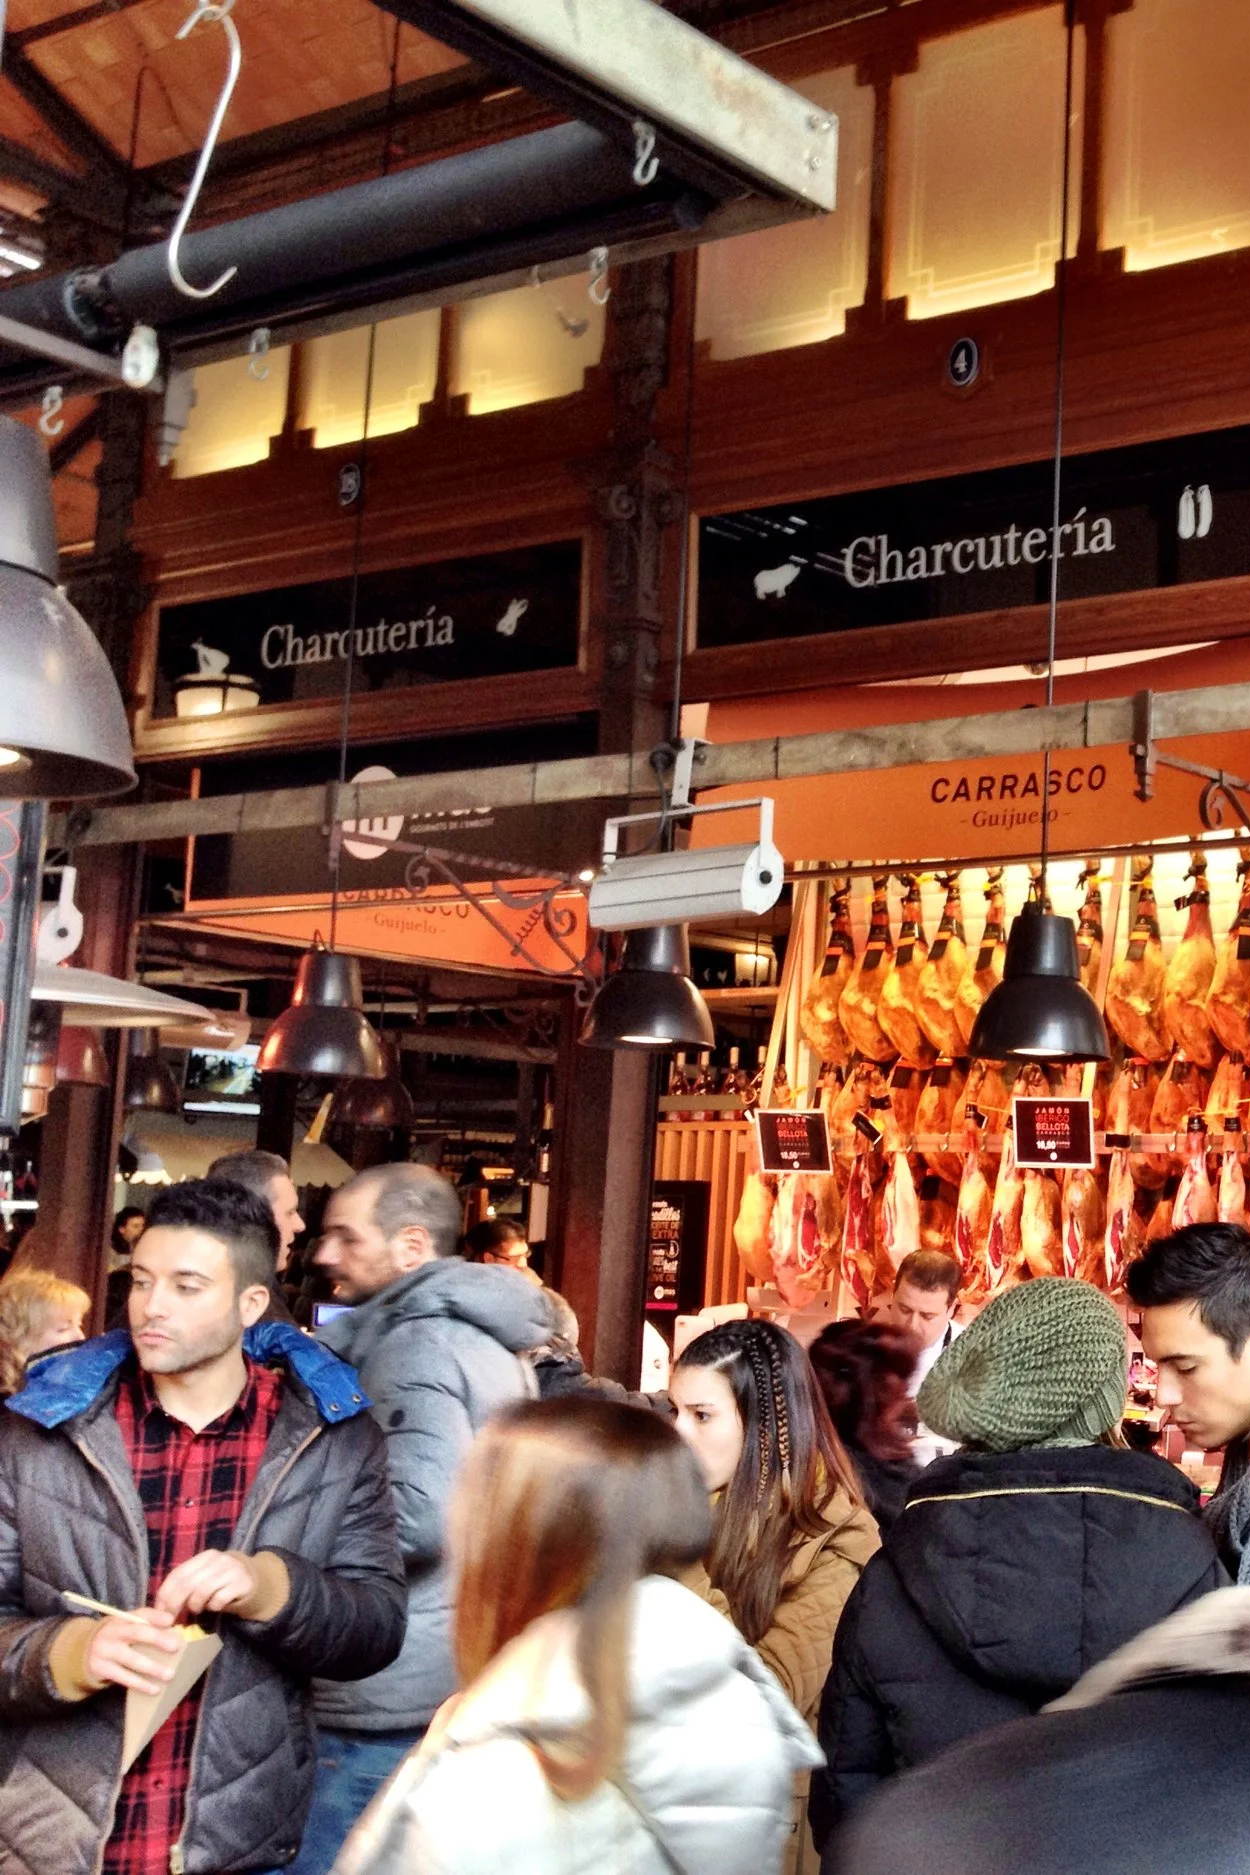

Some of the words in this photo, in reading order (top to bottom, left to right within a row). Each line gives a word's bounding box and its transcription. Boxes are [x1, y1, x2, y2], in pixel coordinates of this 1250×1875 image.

[842, 506, 1116, 588] Charcutería
[260, 605, 455, 669] Charcutería
[930, 764, 1107, 803] CARRASCO
[971, 808, 1059, 830] Guijueo
[374, 912, 437, 935] Guijuelo
[777, 1130, 808, 1138] BELLOTA
[1035, 1122, 1070, 1131] BELLOTA
